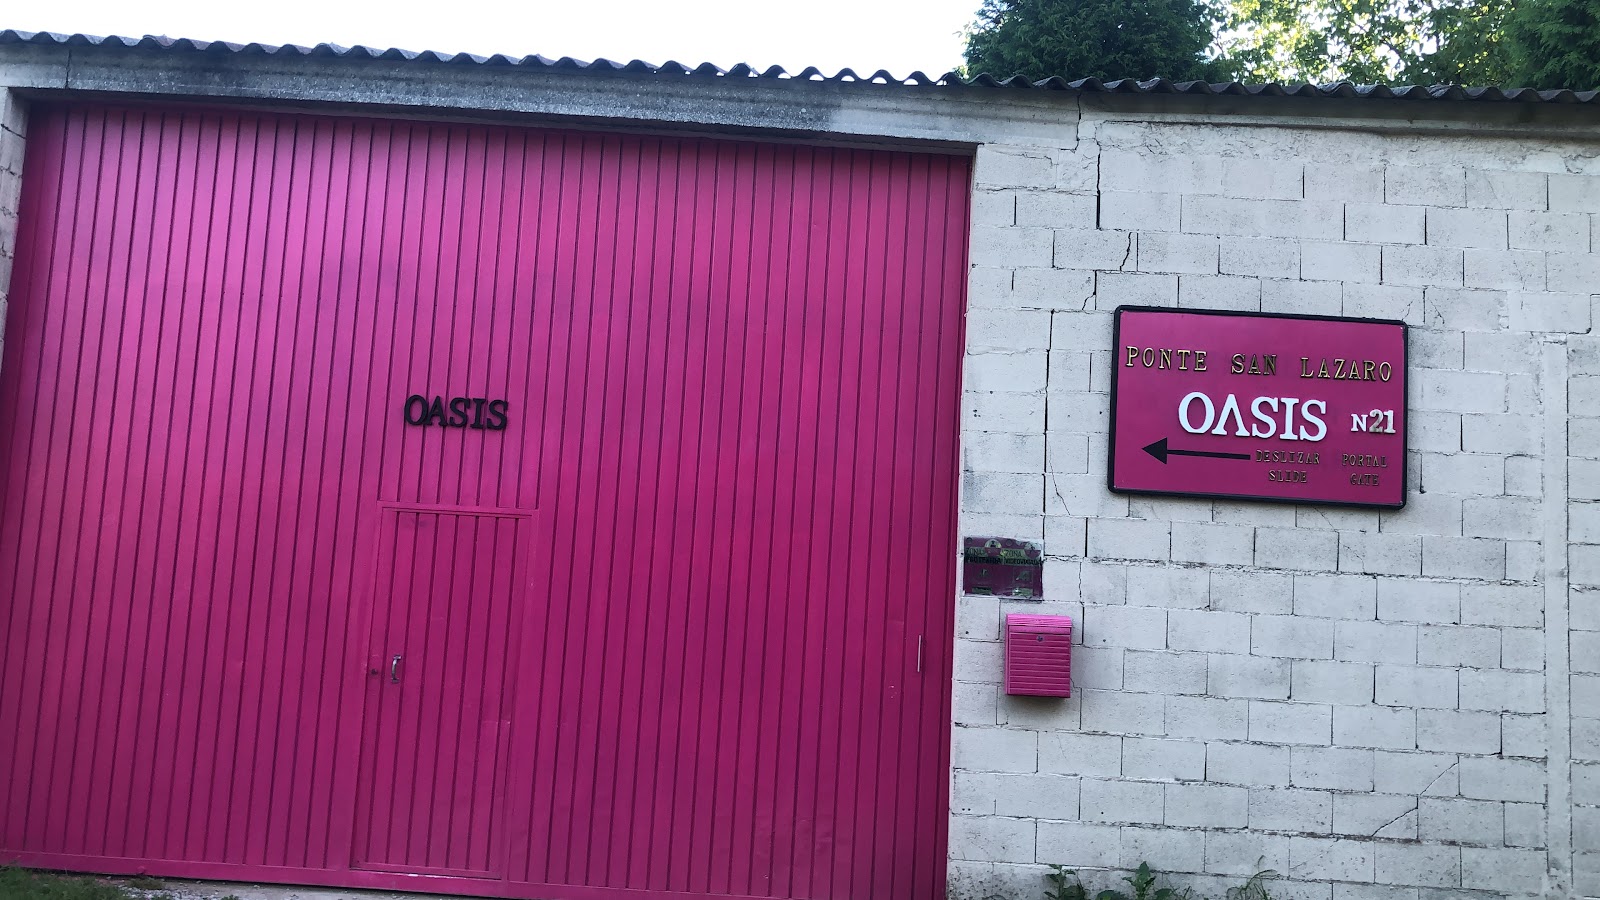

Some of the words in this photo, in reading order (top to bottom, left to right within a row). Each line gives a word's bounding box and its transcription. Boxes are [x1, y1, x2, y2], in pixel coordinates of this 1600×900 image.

[1126, 346, 1207, 372] PONTE
[1231, 352, 1277, 376] SAN
[1301, 357, 1392, 382] LAZARO
[404, 394, 508, 430] OASIS
[1255, 449, 1320, 465] DESLIZAR
[1342, 453, 1387, 468] PORTAL
[1268, 470, 1308, 483] SLIDE
